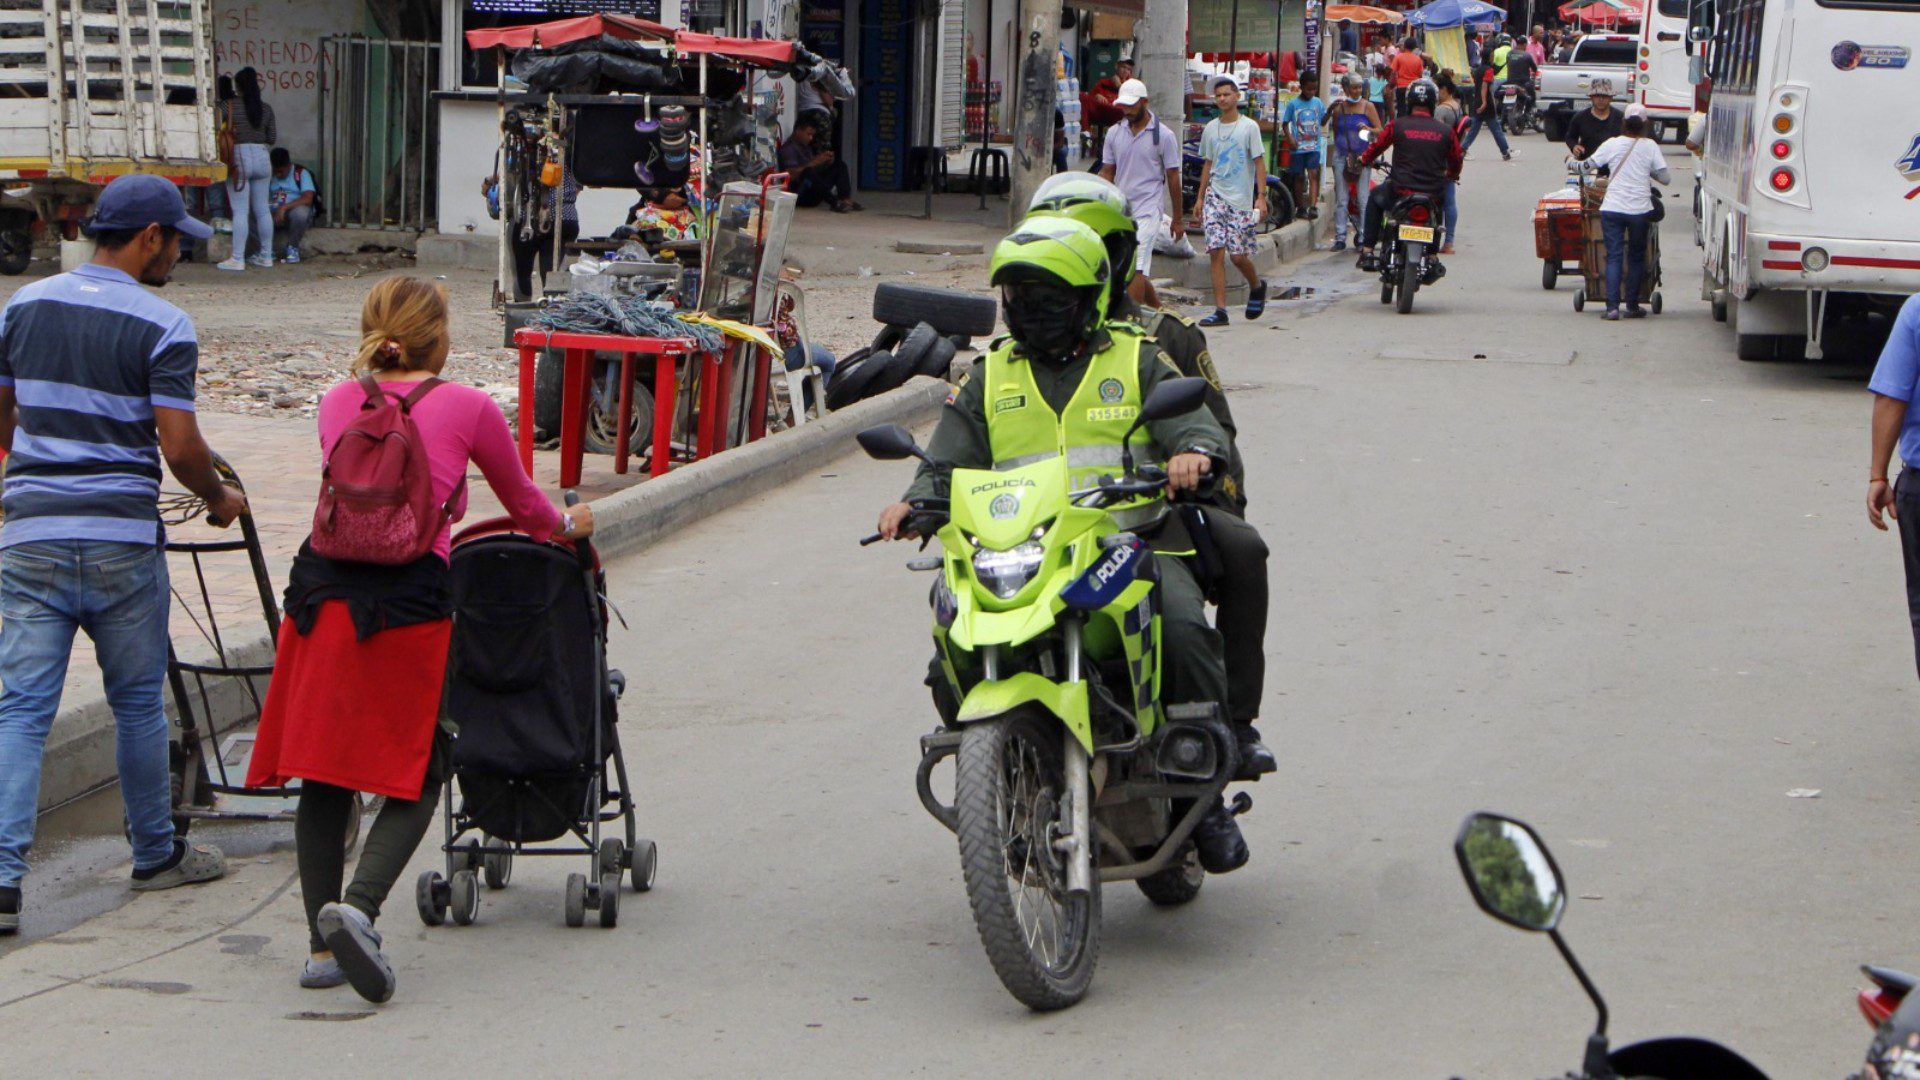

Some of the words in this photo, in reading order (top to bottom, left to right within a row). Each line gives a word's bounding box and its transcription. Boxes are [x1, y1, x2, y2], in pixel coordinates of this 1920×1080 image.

[224, 7, 259, 30] SE
[1865, 57, 1890, 65] 80
[971, 476, 1036, 495] POLICÍA
